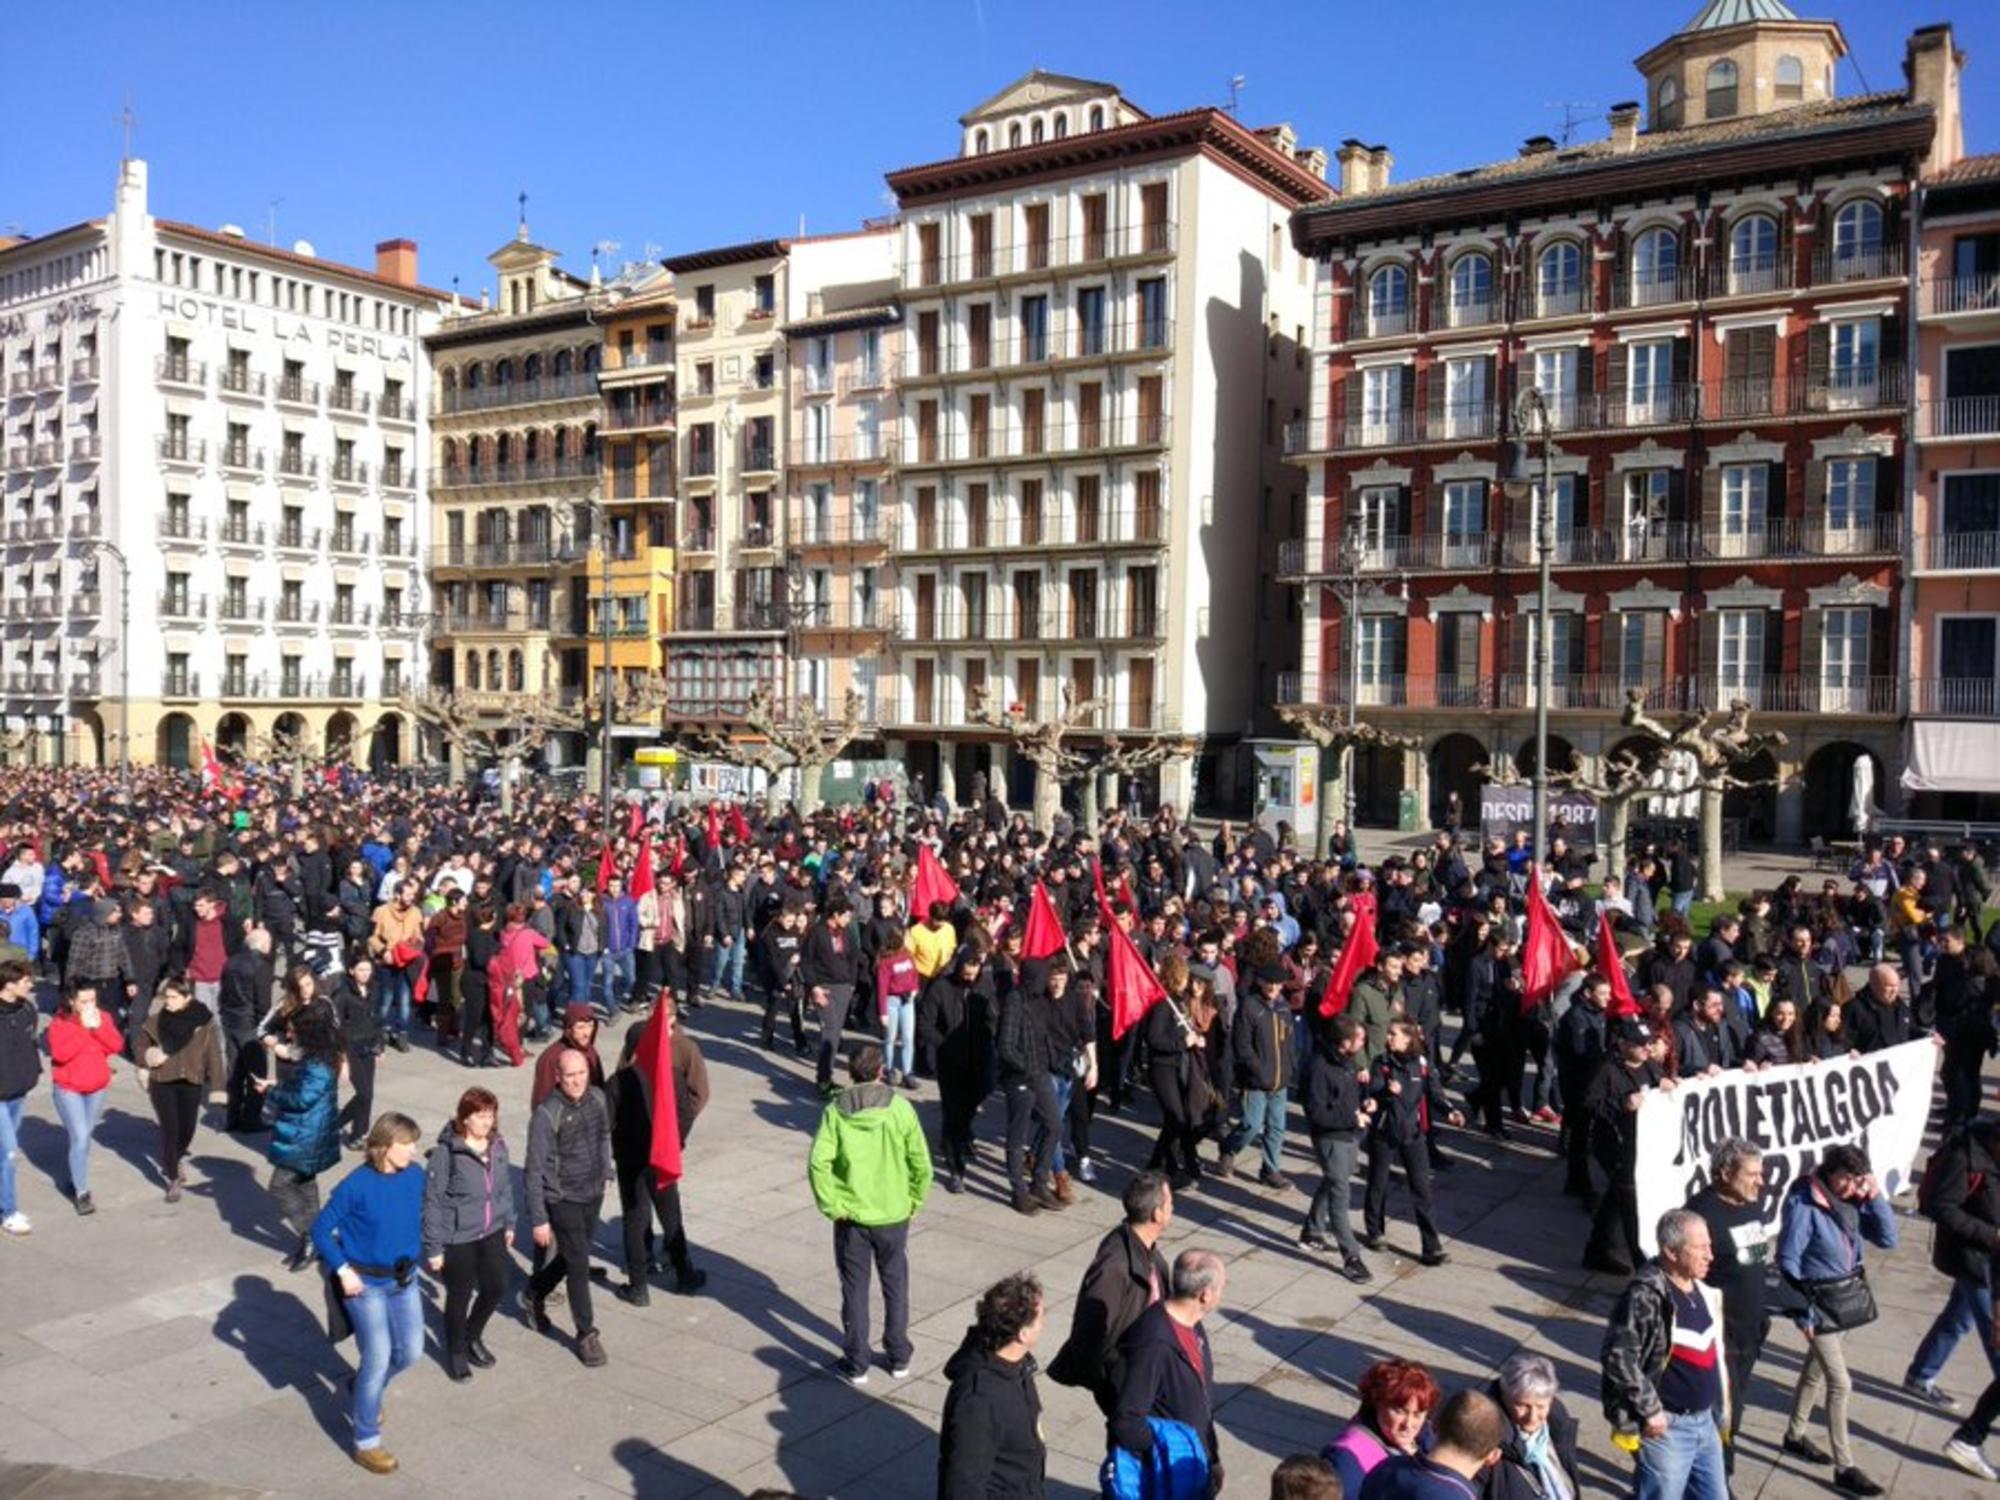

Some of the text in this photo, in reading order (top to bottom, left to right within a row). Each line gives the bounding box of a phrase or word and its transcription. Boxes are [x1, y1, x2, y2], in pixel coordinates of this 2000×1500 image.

[157, 290, 412, 363] HOTEL LA PERLA
[1481, 801, 1597, 825] DESD 1987
